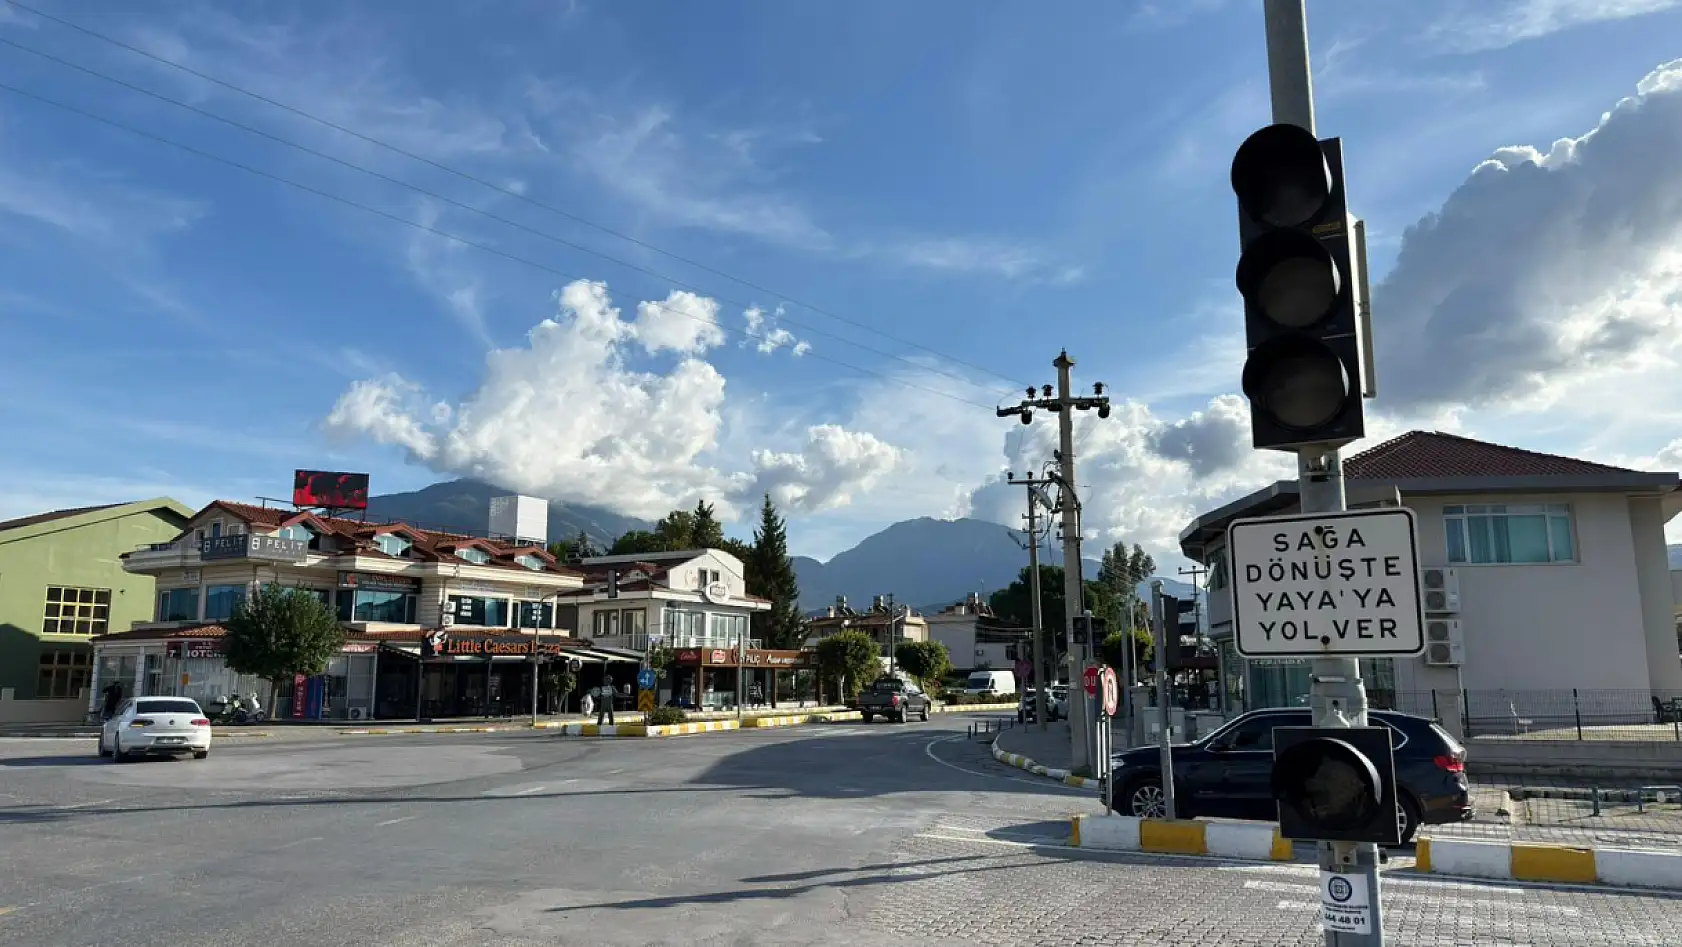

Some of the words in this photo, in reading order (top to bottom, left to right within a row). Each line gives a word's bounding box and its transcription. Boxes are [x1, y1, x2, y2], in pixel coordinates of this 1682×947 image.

[1273, 525, 1366, 552] SAĞA
[1245, 555, 1402, 583] DÖNÜŞTE
[1255, 587, 1396, 612] YAYA'YA
[1258, 620, 1319, 641] YOL
[1332, 618, 1398, 640] VER
[447, 638, 482, 654] Little
[484, 638, 528, 654] Caesars
